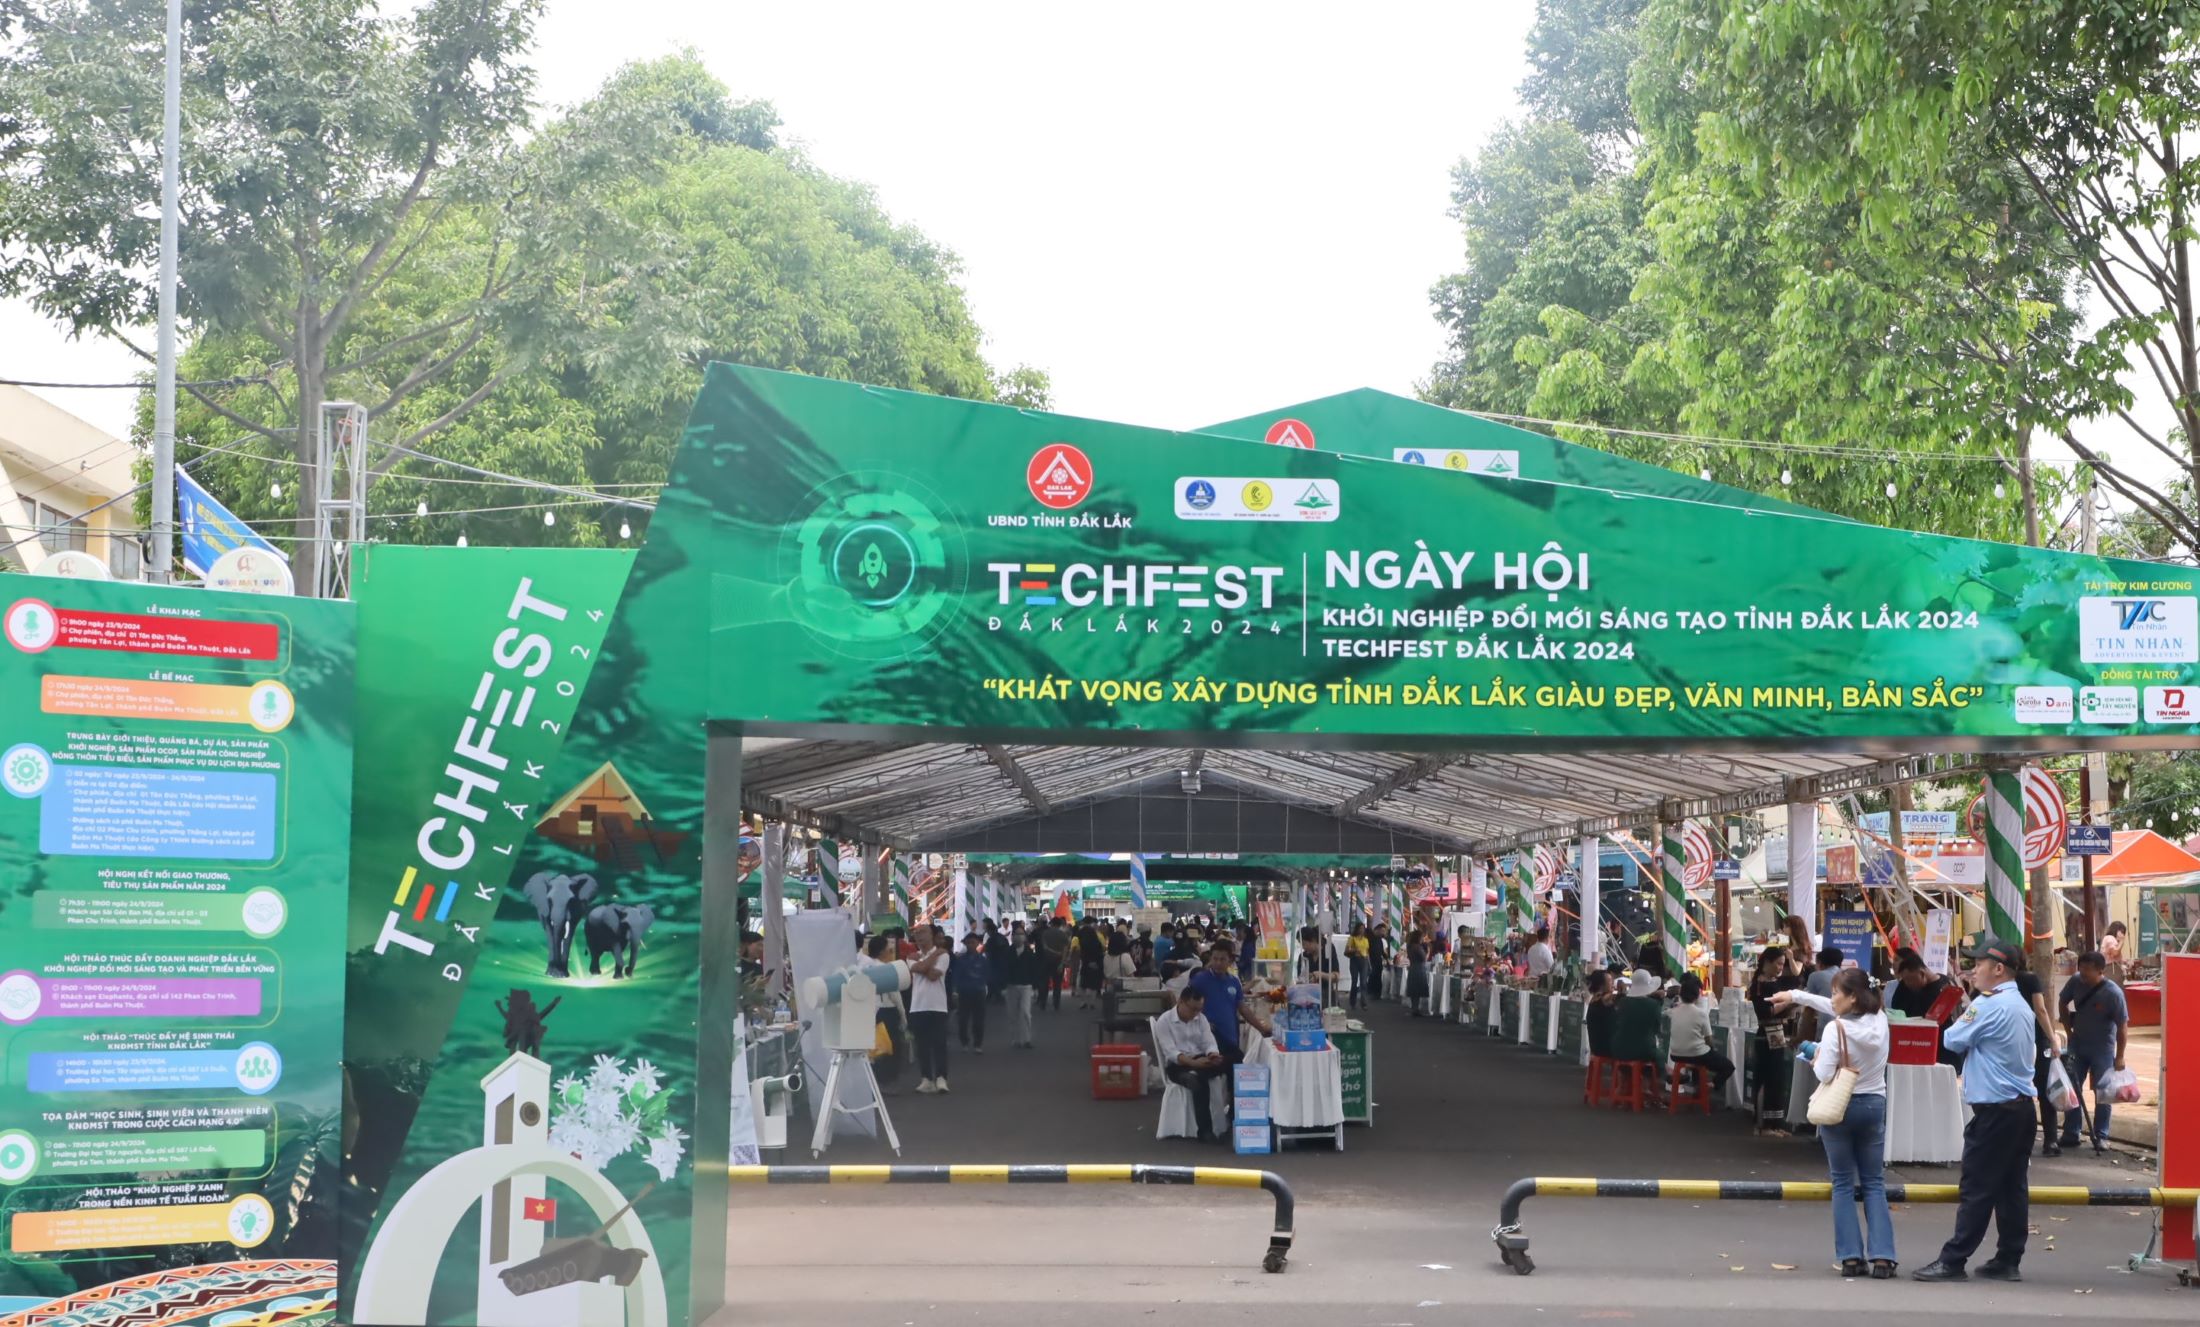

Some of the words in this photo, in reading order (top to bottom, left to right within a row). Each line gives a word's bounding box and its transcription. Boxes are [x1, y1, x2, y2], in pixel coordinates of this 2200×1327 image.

[988, 515, 1028, 526] UBND
[1032, 511, 1065, 527] TỈNH
[1069, 512, 1099, 527] ĐẮK
[1104, 513, 1131, 528] LẮK
[1326, 540, 1475, 589] NGÀY
[1495, 541, 1588, 602] HỘI
[988, 563, 1283, 608] TECHFEST
[2084, 580, 2100, 590] TÀI
[2104, 582, 2128, 592] TRỢ
[2129, 582, 2148, 590] KIM
[2151, 581, 2192, 591] CƯƠNG
[147, 605, 157, 614] LỄ
[181, 610, 200, 618] MẠC
[988, 612, 1062, 631] ĐẮK
[1088, 613, 1158, 633] LẮK
[1183, 619, 1280, 634] 2024
[1324, 603, 1383, 626] KHỞI
[1392, 605, 1485, 632] NGHIỆP
[1492, 603, 1536, 628] ĐỔI
[1546, 607, 1591, 629] MỚI
[1600, 607, 1668, 629] SÁNG
[1676, 612, 1726, 634] TẠO
[1734, 606, 1792, 629] TỈNH
[1801, 604, 1853, 629] ĐẮK
[1862, 603, 1910, 629] LẮK
[1918, 611, 1980, 629] 2024
[1323, 639, 1448, 657] TECHFEST
[1456, 634, 1508, 658] ĐẮK
[1518, 634, 1565, 659] LẮK
[1574, 642, 1634, 659] 2024
[2096, 638, 2124, 649] TIN
[2136, 638, 2182, 649] NHAN
[149, 671, 160, 680] LỄ
[162, 672, 173, 681] BẾ
[175, 675, 194, 684] MẠC
[2102, 668, 2132, 680] ĐỒNG
[2136, 669, 2152, 680] TÀI
[2156, 670, 2179, 681] TRỢ
[984, 674, 1072, 700] “KHÁT
[1081, 681, 1162, 706] VỌNG
[1172, 676, 1227, 702] XÂY
[1237, 681, 1317, 708] DỰNG
[1326, 677, 1391, 704] TỈNH
[1403, 676, 1461, 705] ĐẮK
[1472, 677, 1526, 705] LẮK
[1536, 681, 1604, 707] GIÀU
[1615, 687, 1675, 713] ĐẸP,
[1685, 682, 1742, 707] VĂN
[1754, 688, 1832, 711] MINH,
[1843, 680, 1901, 707] BẢN
[1912, 678, 1982, 707] SẮC”
[373, 576, 569, 957] TECHFEST
[442, 881, 497, 982] ĐẮK
[492, 760, 545, 856] LẮK
[540, 606, 605, 735] 2024
[1904, 814, 1948, 823] TRANG
[98, 870, 114, 880] HỘI
[115, 872, 136, 880] NGHỊ
[137, 870, 153, 879] KẾT
[155, 870, 171, 879] NỐI
[103, 880, 122, 889] TIÊU
[123, 883, 140, 891] THỤ
[142, 881, 159, 890] SẢN
[161, 881, 185, 890] PHẨM
[186, 882, 205, 891] NĂM
[64, 954, 80, 964] HỘI
[83, 954, 107, 962] THẢO
[110, 954, 132, 962] THÚC
[135, 953, 152, 962] ĐẨY
[187, 954, 219, 964] NGHIỆP
[221, 954, 238, 963] ĐẮK
[240, 954, 256, 963] LẮK
[66, 964, 98, 974] NGHIỆP
[99, 964, 115, 973] ĐỔI
[116, 964, 132, 973] MỚI
[134, 964, 156, 973] SÁNG
[159, 966, 174, 975] TẠO
[176, 964, 187, 973] VÀ
[188, 964, 209, 973] PHÁT
[211, 964, 234, 973] TRIỂN
[235, 964, 251, 973] BỀN
[253, 964, 275, 973] VỮNG
[83, 1033, 100, 1043] HỘI
[102, 1033, 127, 1041] THẢO
[159, 1031, 177, 1040] ĐẨY
[179, 1032, 190, 1042] HỆ
[215, 1031, 235, 1040] THÁI
[146, 1041, 167, 1049] TỈNH
[169, 1040, 187, 1049] ĐẮK
[43, 1113, 62, 1122] TỌA
[65, 1111, 87, 1120] ĐÀM
[172, 1108, 194, 1117] VIÊN
[197, 1108, 209, 1116] VÀ
[246, 1106, 269, 1115] NIÊN
[145, 1119, 170, 1130] CUỘC
[172, 1118, 196, 1127] CÁCH
[198, 1119, 224, 1128] MẠNG
[85, 1188, 103, 1199] HỘI
[105, 1186, 131, 1196] THẢO
[162, 1184, 196, 1195] NGHIỆP
[113, 1197, 133, 1207] NỀN
[159, 1195, 170, 1205] TẾ
[172, 1194, 197, 1204] TUẦN
